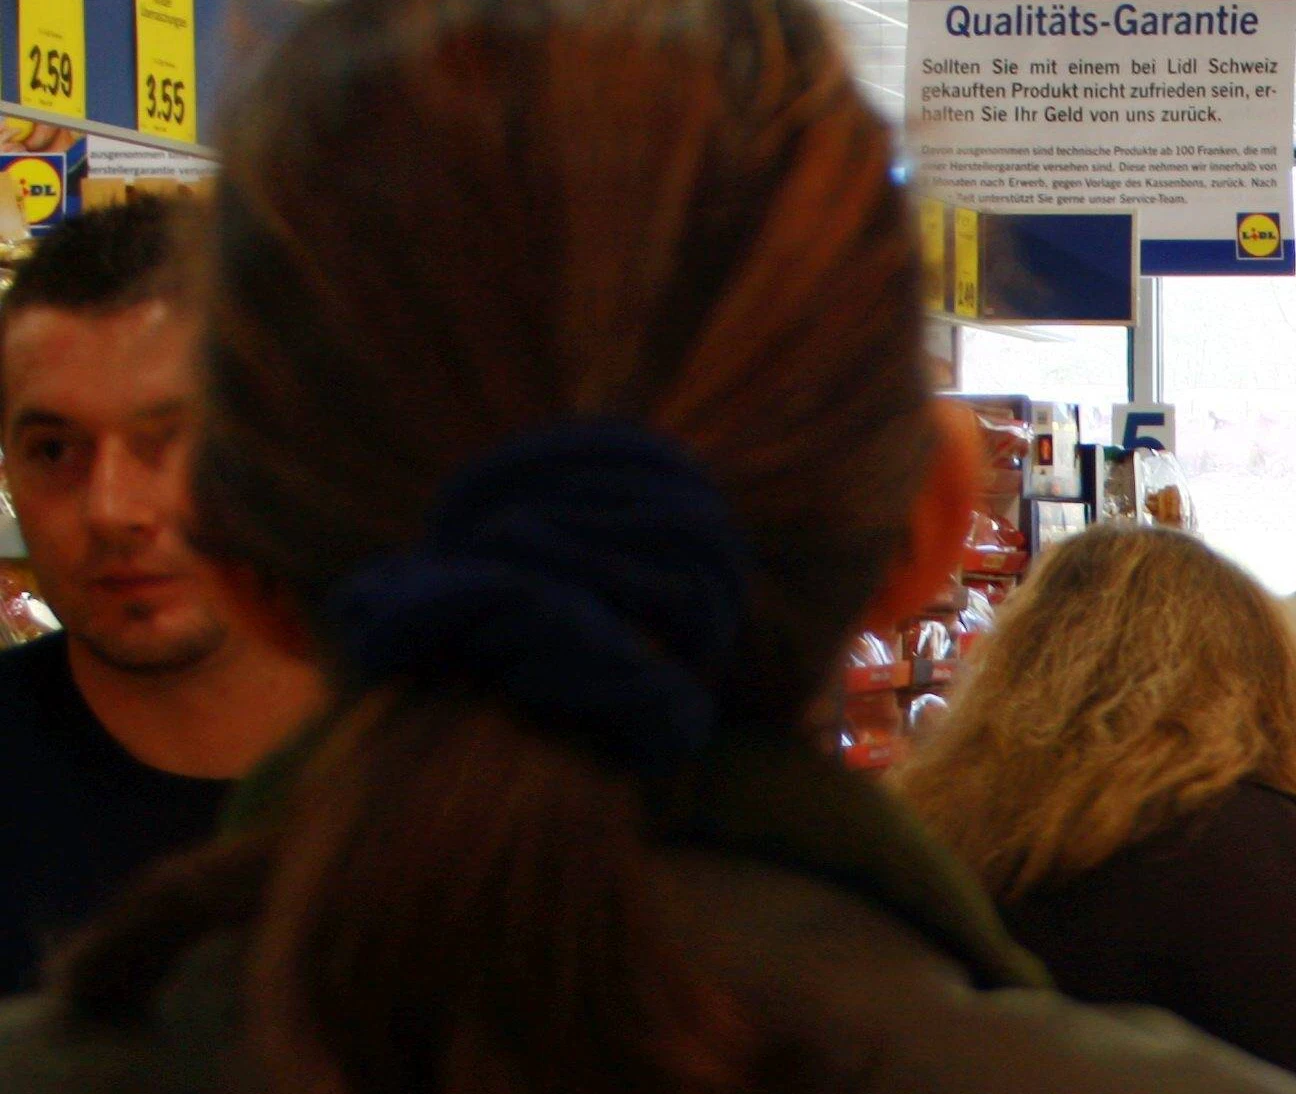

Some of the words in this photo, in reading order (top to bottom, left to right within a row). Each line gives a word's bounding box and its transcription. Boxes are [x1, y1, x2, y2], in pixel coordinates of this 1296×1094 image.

[945, 4, 1260, 39] Qualitäts-Garantie
[28, 44, 73, 98] 2.59
[922, 58, 981, 75] Sollten
[992, 58, 1019, 75] Sie
[1030, 58, 1057, 75] mit
[1068, 59, 1120, 75] einem
[1131, 58, 1156, 75] bei
[1168, 58, 1197, 75] Lidl
[1208, 57, 1278, 74] Schweiz
[146, 73, 185, 126] 3.55
[921, 83, 1006, 101] gekauften
[1011, 82, 1078, 98] Produkt
[1083, 82, 1125, 98] nicht
[1130, 82, 1206, 99] zufrieden
[1211, 82, 1250, 101] sein,
[1255, 87, 1277, 98] er-
[921, 106, 974, 123] halten
[981, 106, 1007, 123] Sie
[1015, 106, 1037, 122] Ihr
[1044, 106, 1083, 122] Geld
[1090, 110, 1119, 122] von
[1126, 110, 1155, 122] uns
[1161, 105, 1222, 123] zurück.
[1175, 145, 1195, 155] 100
